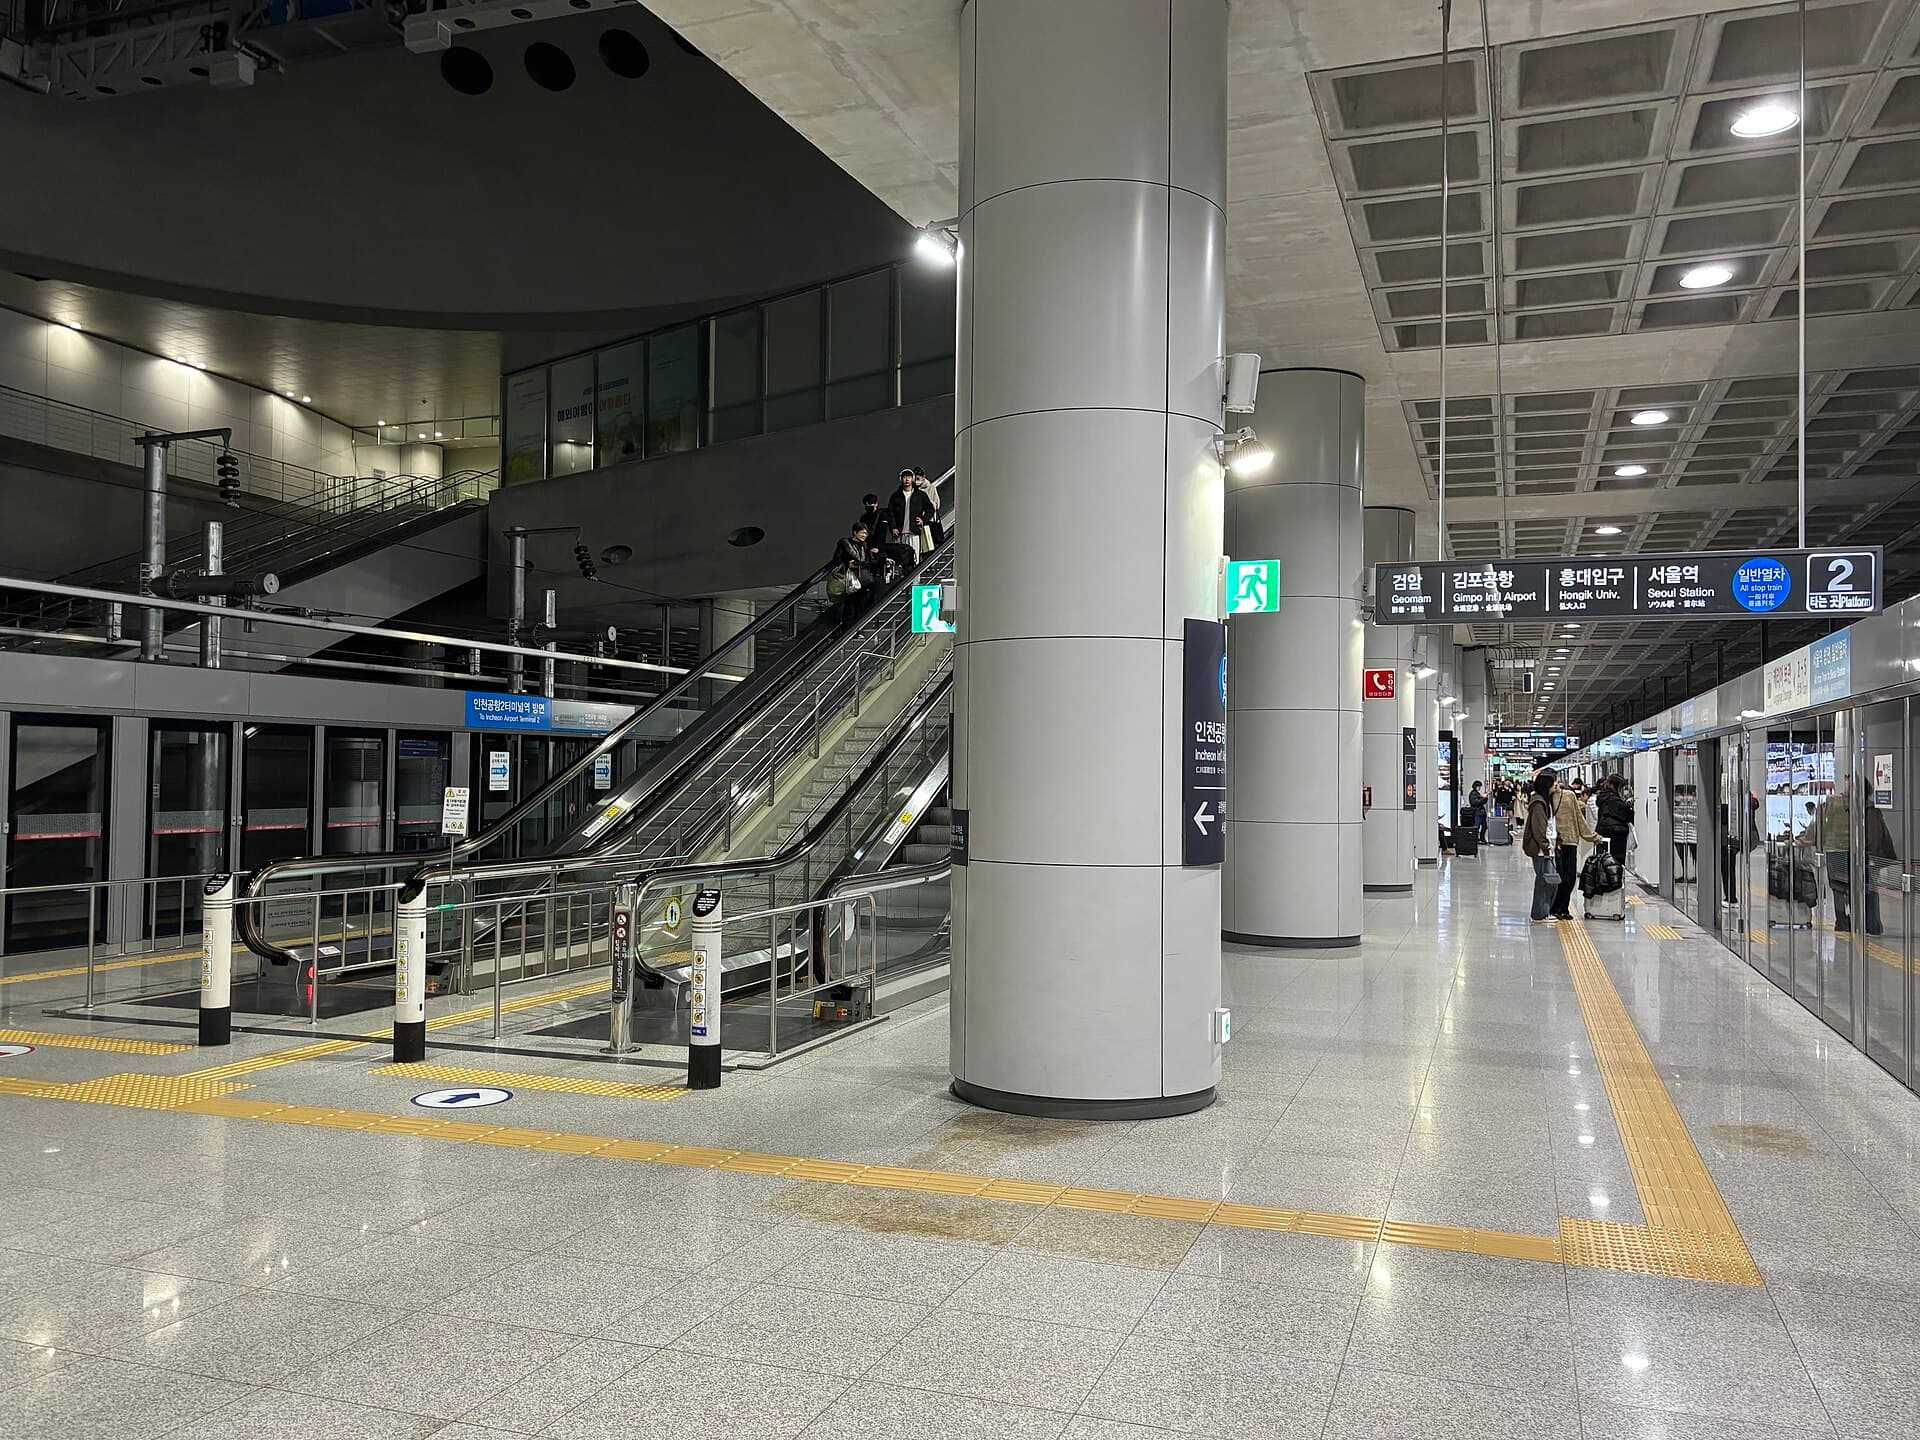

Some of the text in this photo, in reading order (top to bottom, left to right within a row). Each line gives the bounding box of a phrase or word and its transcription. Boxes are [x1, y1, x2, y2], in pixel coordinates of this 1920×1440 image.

[1452, 570, 1515, 589] 김포공항
[1559, 567, 1625, 587] 홍대입구
[1647, 565, 1699, 584] 서울역
[1738, 567, 1786, 582] 일반열차
[1827, 558, 1854, 592] 2
[1392, 573, 1423, 591] 검암
[1739, 583, 1783, 593] All stop train
[1391, 595, 1432, 604] Geomam
[1453, 592, 1483, 603] Gimpo
[1503, 591, 1537, 602] Airport
[1559, 589, 1621, 601] Hongik Univ.
[1647, 587, 1715, 599] Seoul Station
[1809, 595, 1828, 608] 타는
[1840, 595, 1871, 608] Platform
[473, 697, 545, 715] 인천공항2터미널역 방면
[486, 714, 503, 722] Incheon
[504, 715, 519, 723] Airport
[1195, 748, 1217, 761] Incheon
